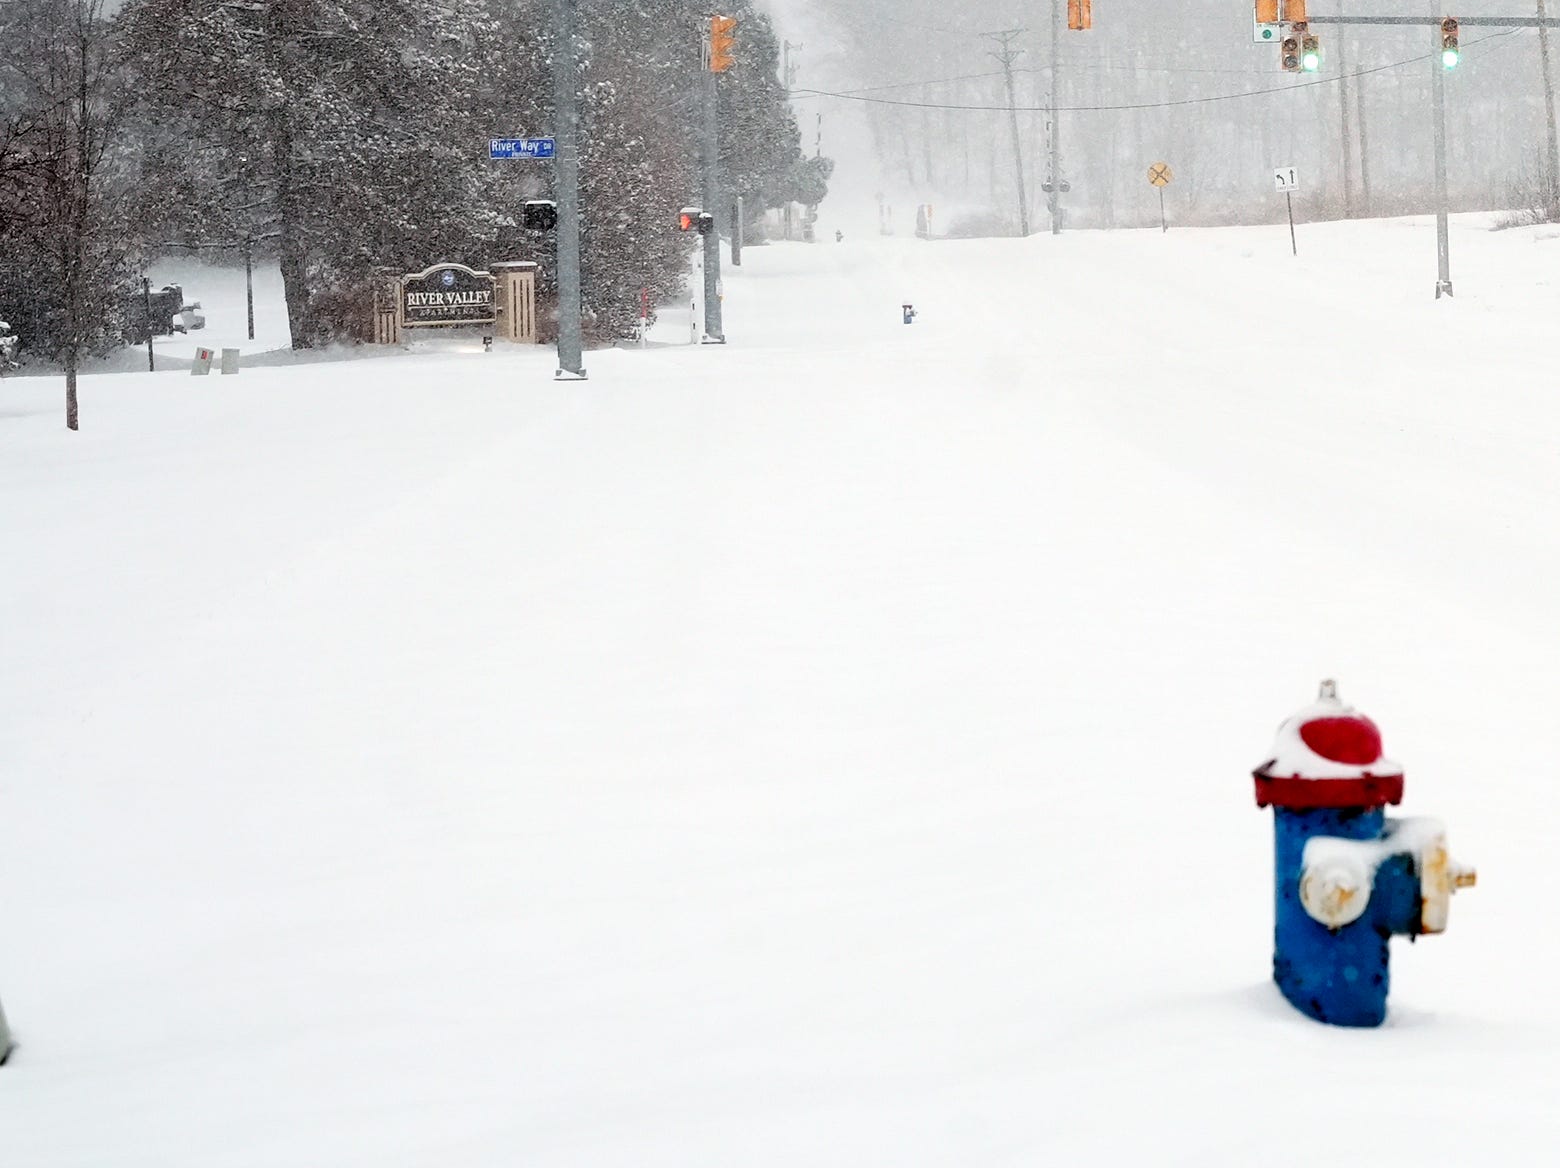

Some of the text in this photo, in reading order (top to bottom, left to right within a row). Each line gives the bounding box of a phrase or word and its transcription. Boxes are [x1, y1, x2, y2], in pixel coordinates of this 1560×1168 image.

[491, 140, 516, 152] River
[519, 140, 540, 153] Way
[407, 290, 491, 306] RIVER VALLEY
